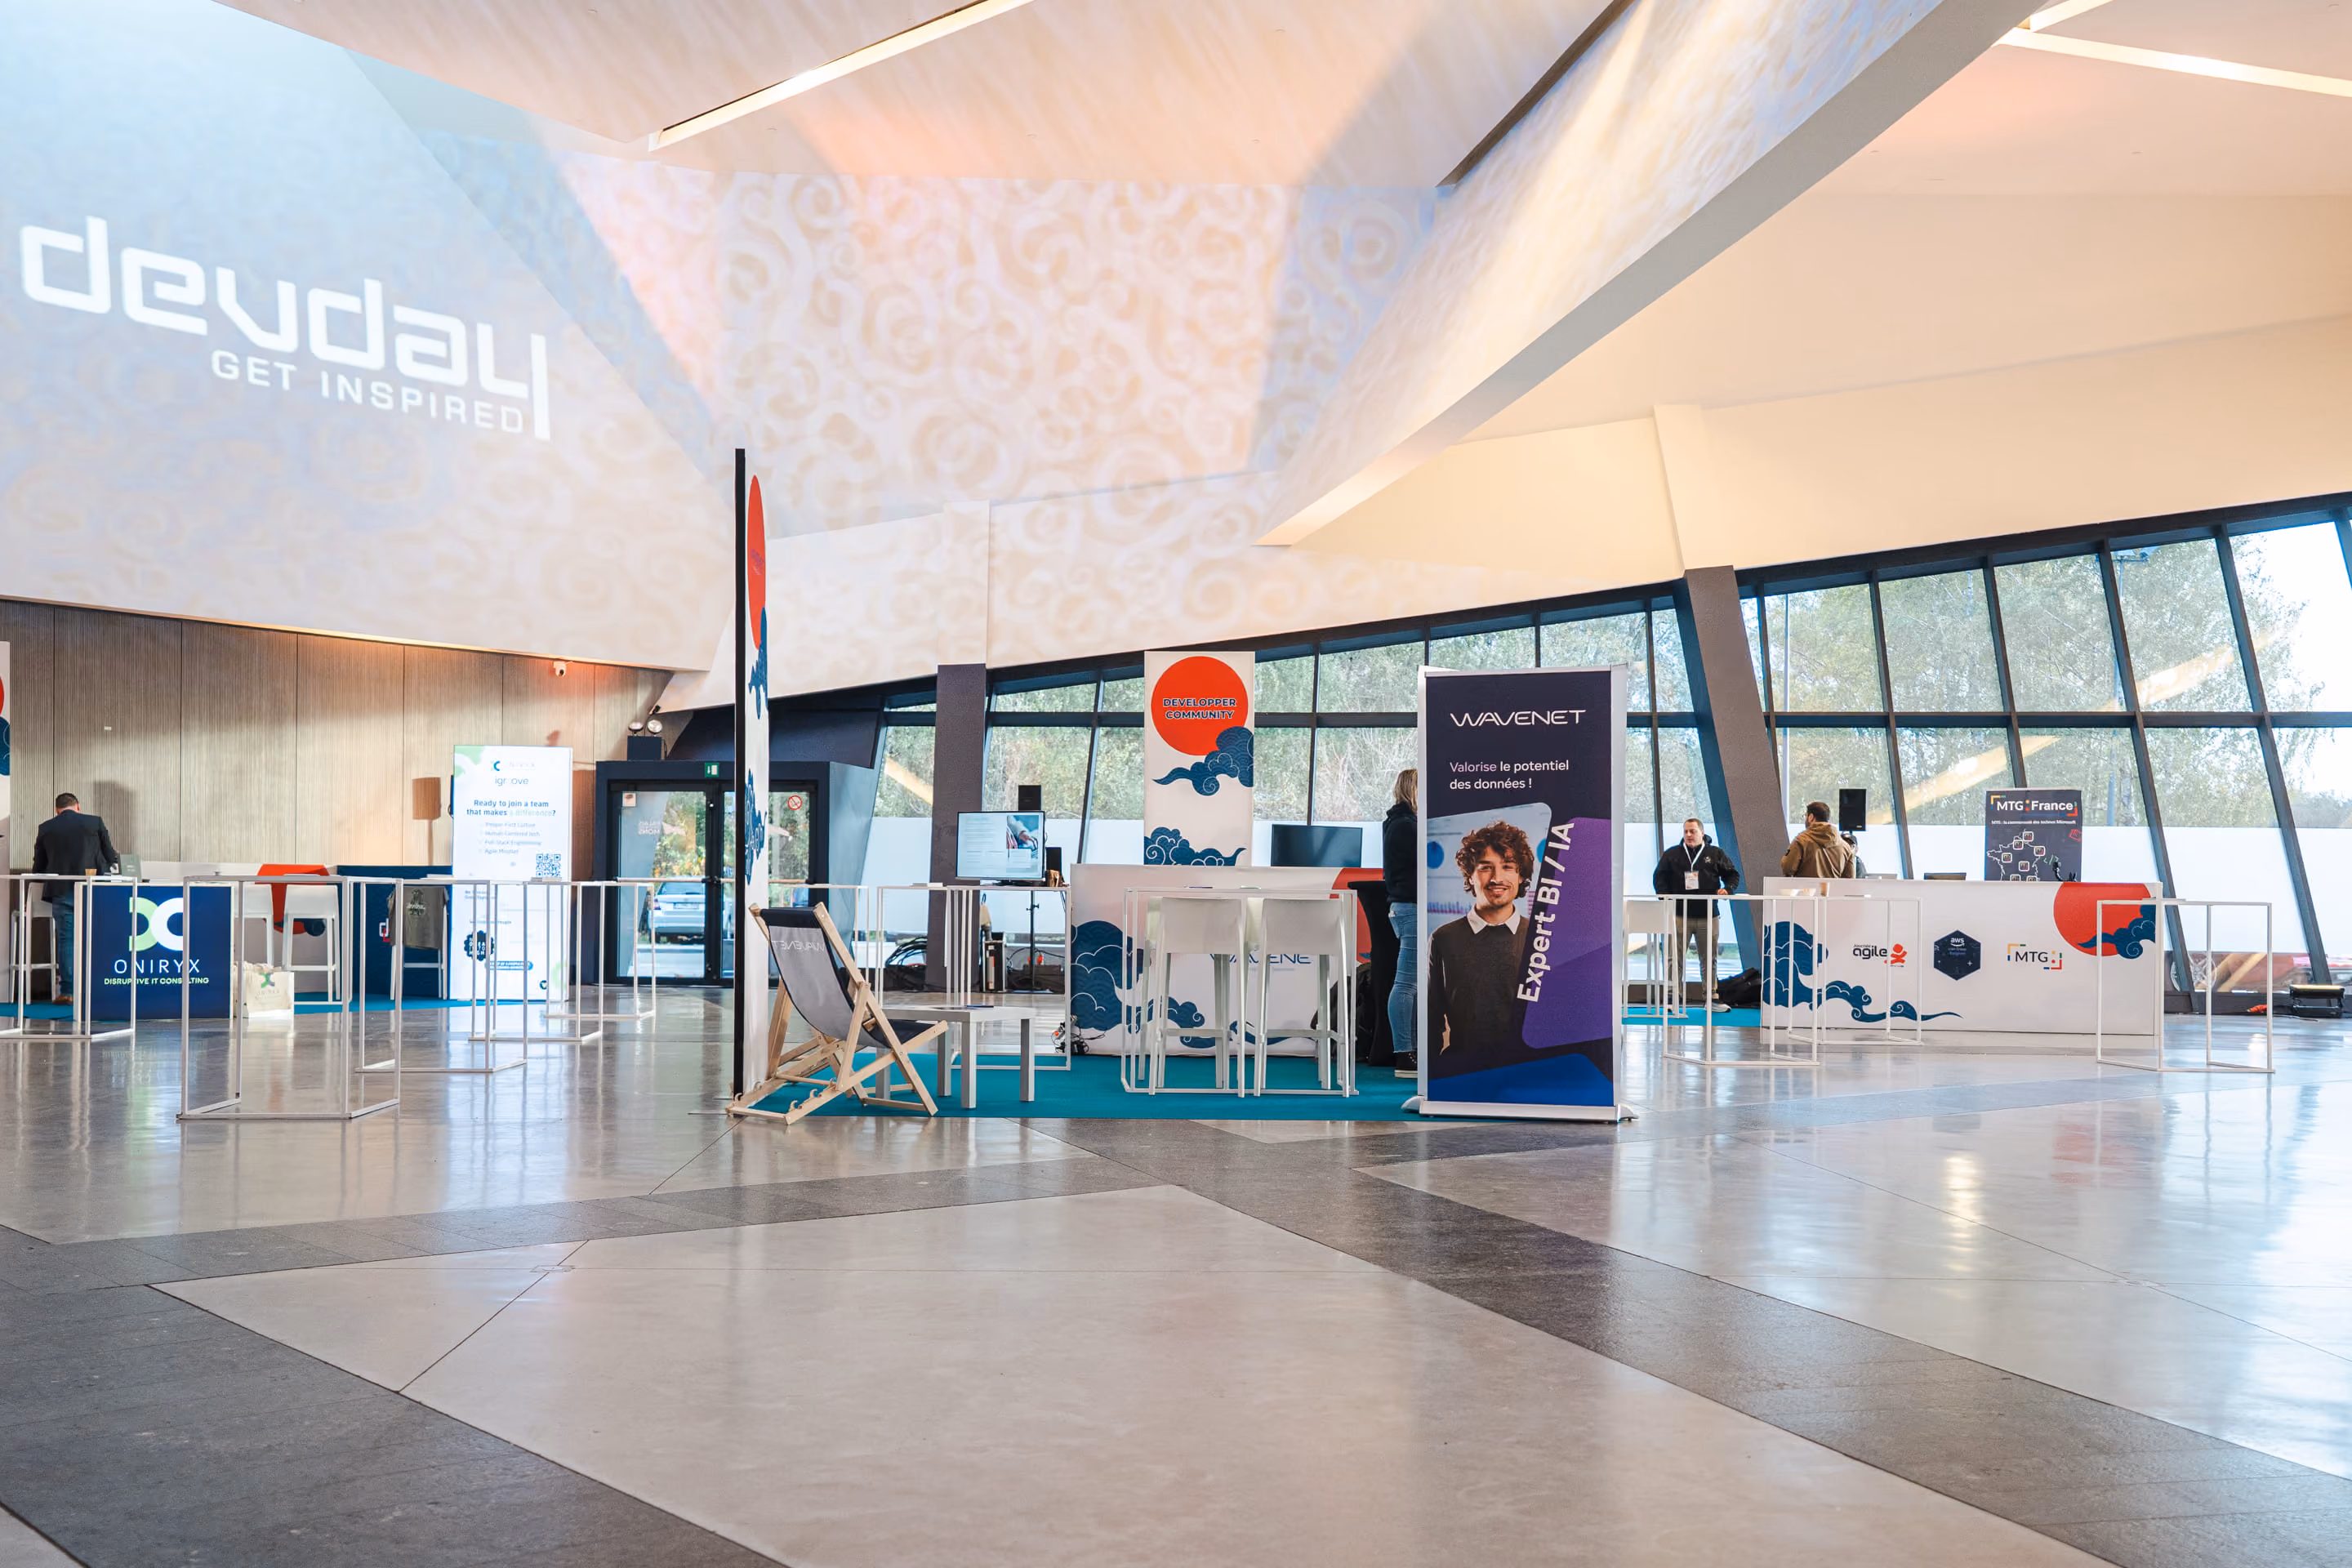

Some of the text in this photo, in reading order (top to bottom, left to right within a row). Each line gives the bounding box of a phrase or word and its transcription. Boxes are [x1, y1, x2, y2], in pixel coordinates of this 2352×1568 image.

[20, 215, 550, 441] devday
[212, 350, 524, 434] GET INSPIRED
[1163, 698, 1236, 706] DEVELOPPER
[1165, 710, 1234, 719] COMMUNITY
[1450, 710, 1586, 727] WAVENET
[1450, 760, 1569, 773] Valorise le potentiel
[1450, 778, 1471, 790] des
[1474, 777, 1526, 790] données
[1548, 823, 1575, 850] IA
[1537, 878, 1562, 905] BI
[1517, 911, 1556, 1003] Expert
[1853, 945, 1887, 960] agile
[114, 959, 200, 974] ONIRYX
